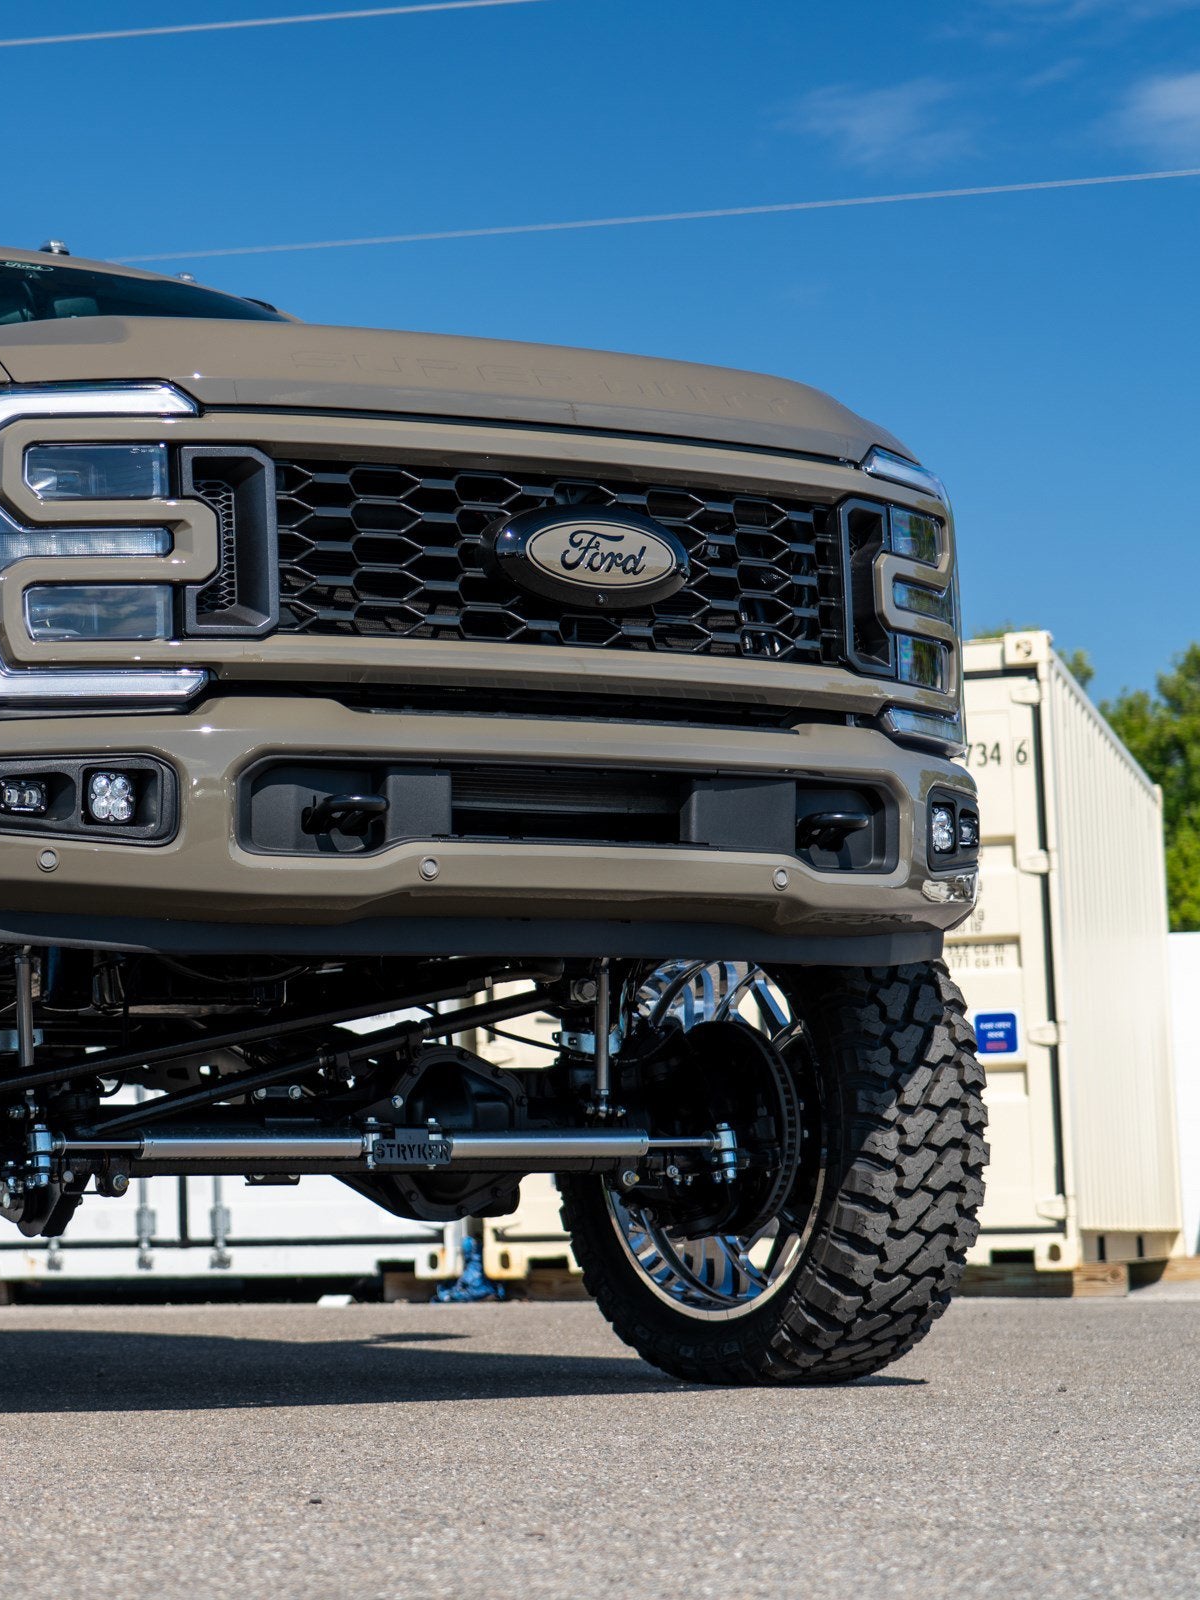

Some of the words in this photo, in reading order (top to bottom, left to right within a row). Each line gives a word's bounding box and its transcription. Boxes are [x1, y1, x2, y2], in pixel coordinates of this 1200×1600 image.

[560, 529, 647, 576] Ford
[1015, 739, 1028, 766] 6
[375, 1143, 449, 1161] STRYKER
